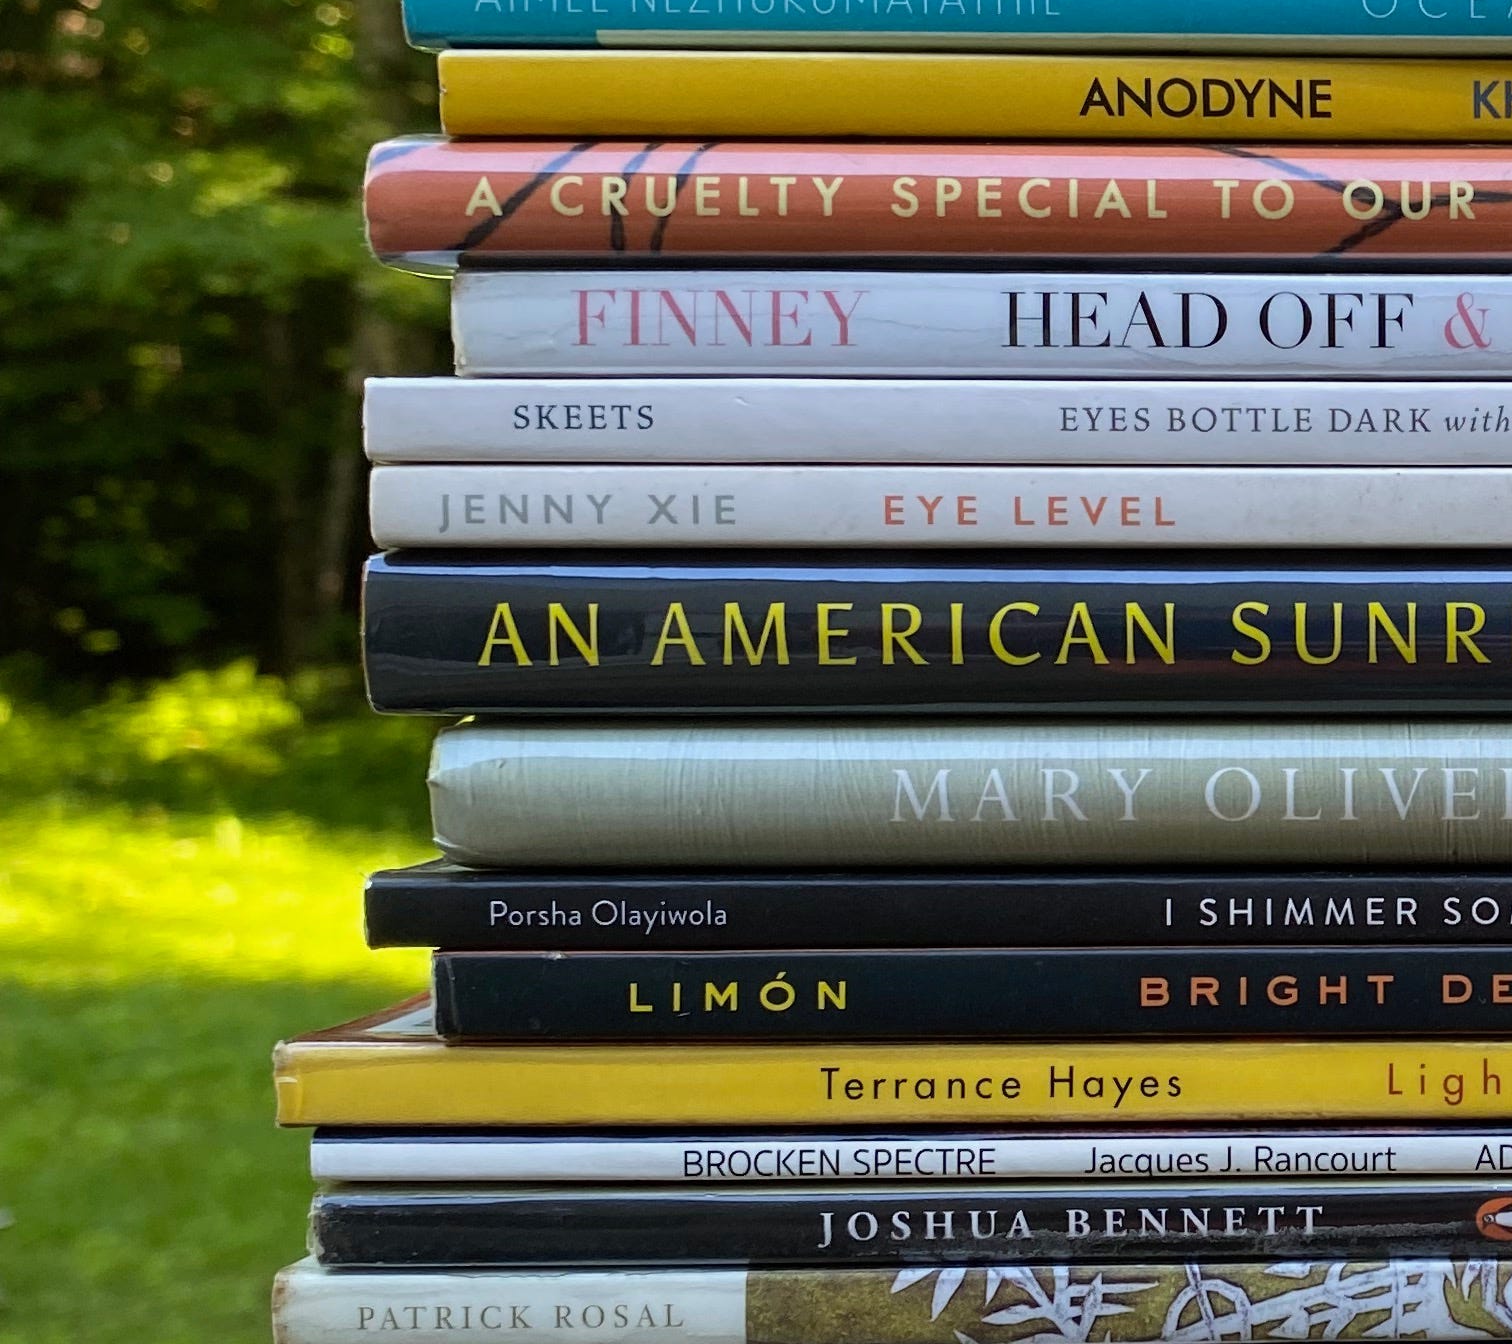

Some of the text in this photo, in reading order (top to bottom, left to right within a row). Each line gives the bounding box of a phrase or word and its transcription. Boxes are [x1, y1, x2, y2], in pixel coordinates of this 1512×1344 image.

[1080, 77, 1332, 119] ANODYNE
[466, 176, 504, 216] A
[551, 176, 845, 216] CRUELTY
[892, 177, 1166, 218] SPECIAL
[1213, 181, 1295, 219] TO
[1343, 181, 1476, 220] OUR
[572, 290, 869, 345] FINNEY
[1060, 407, 1153, 433] EYES
[1168, 407, 1312, 434] BOTTLE
[1329, 409, 1431, 433] DARK
[1445, 406, 1511, 433] with
[440, 494, 737, 532] JENNY XIE
[489, 900, 727, 934] Porsha Olayiwola
[630, 971, 848, 1013] LIMÓN
[1140, 975, 1394, 1007] BRIGHT
[820, 1066, 1183, 1109] Terrance Hayes
[683, 1149, 995, 1177] BROCKEN SPECTRE
[1085, 1146, 1396, 1174] Jacques J. Rancourt
[817, 1206, 1323, 1248] JOSHUA BENNETT
[356, 1303, 683, 1332] PATRICK ROSAL
